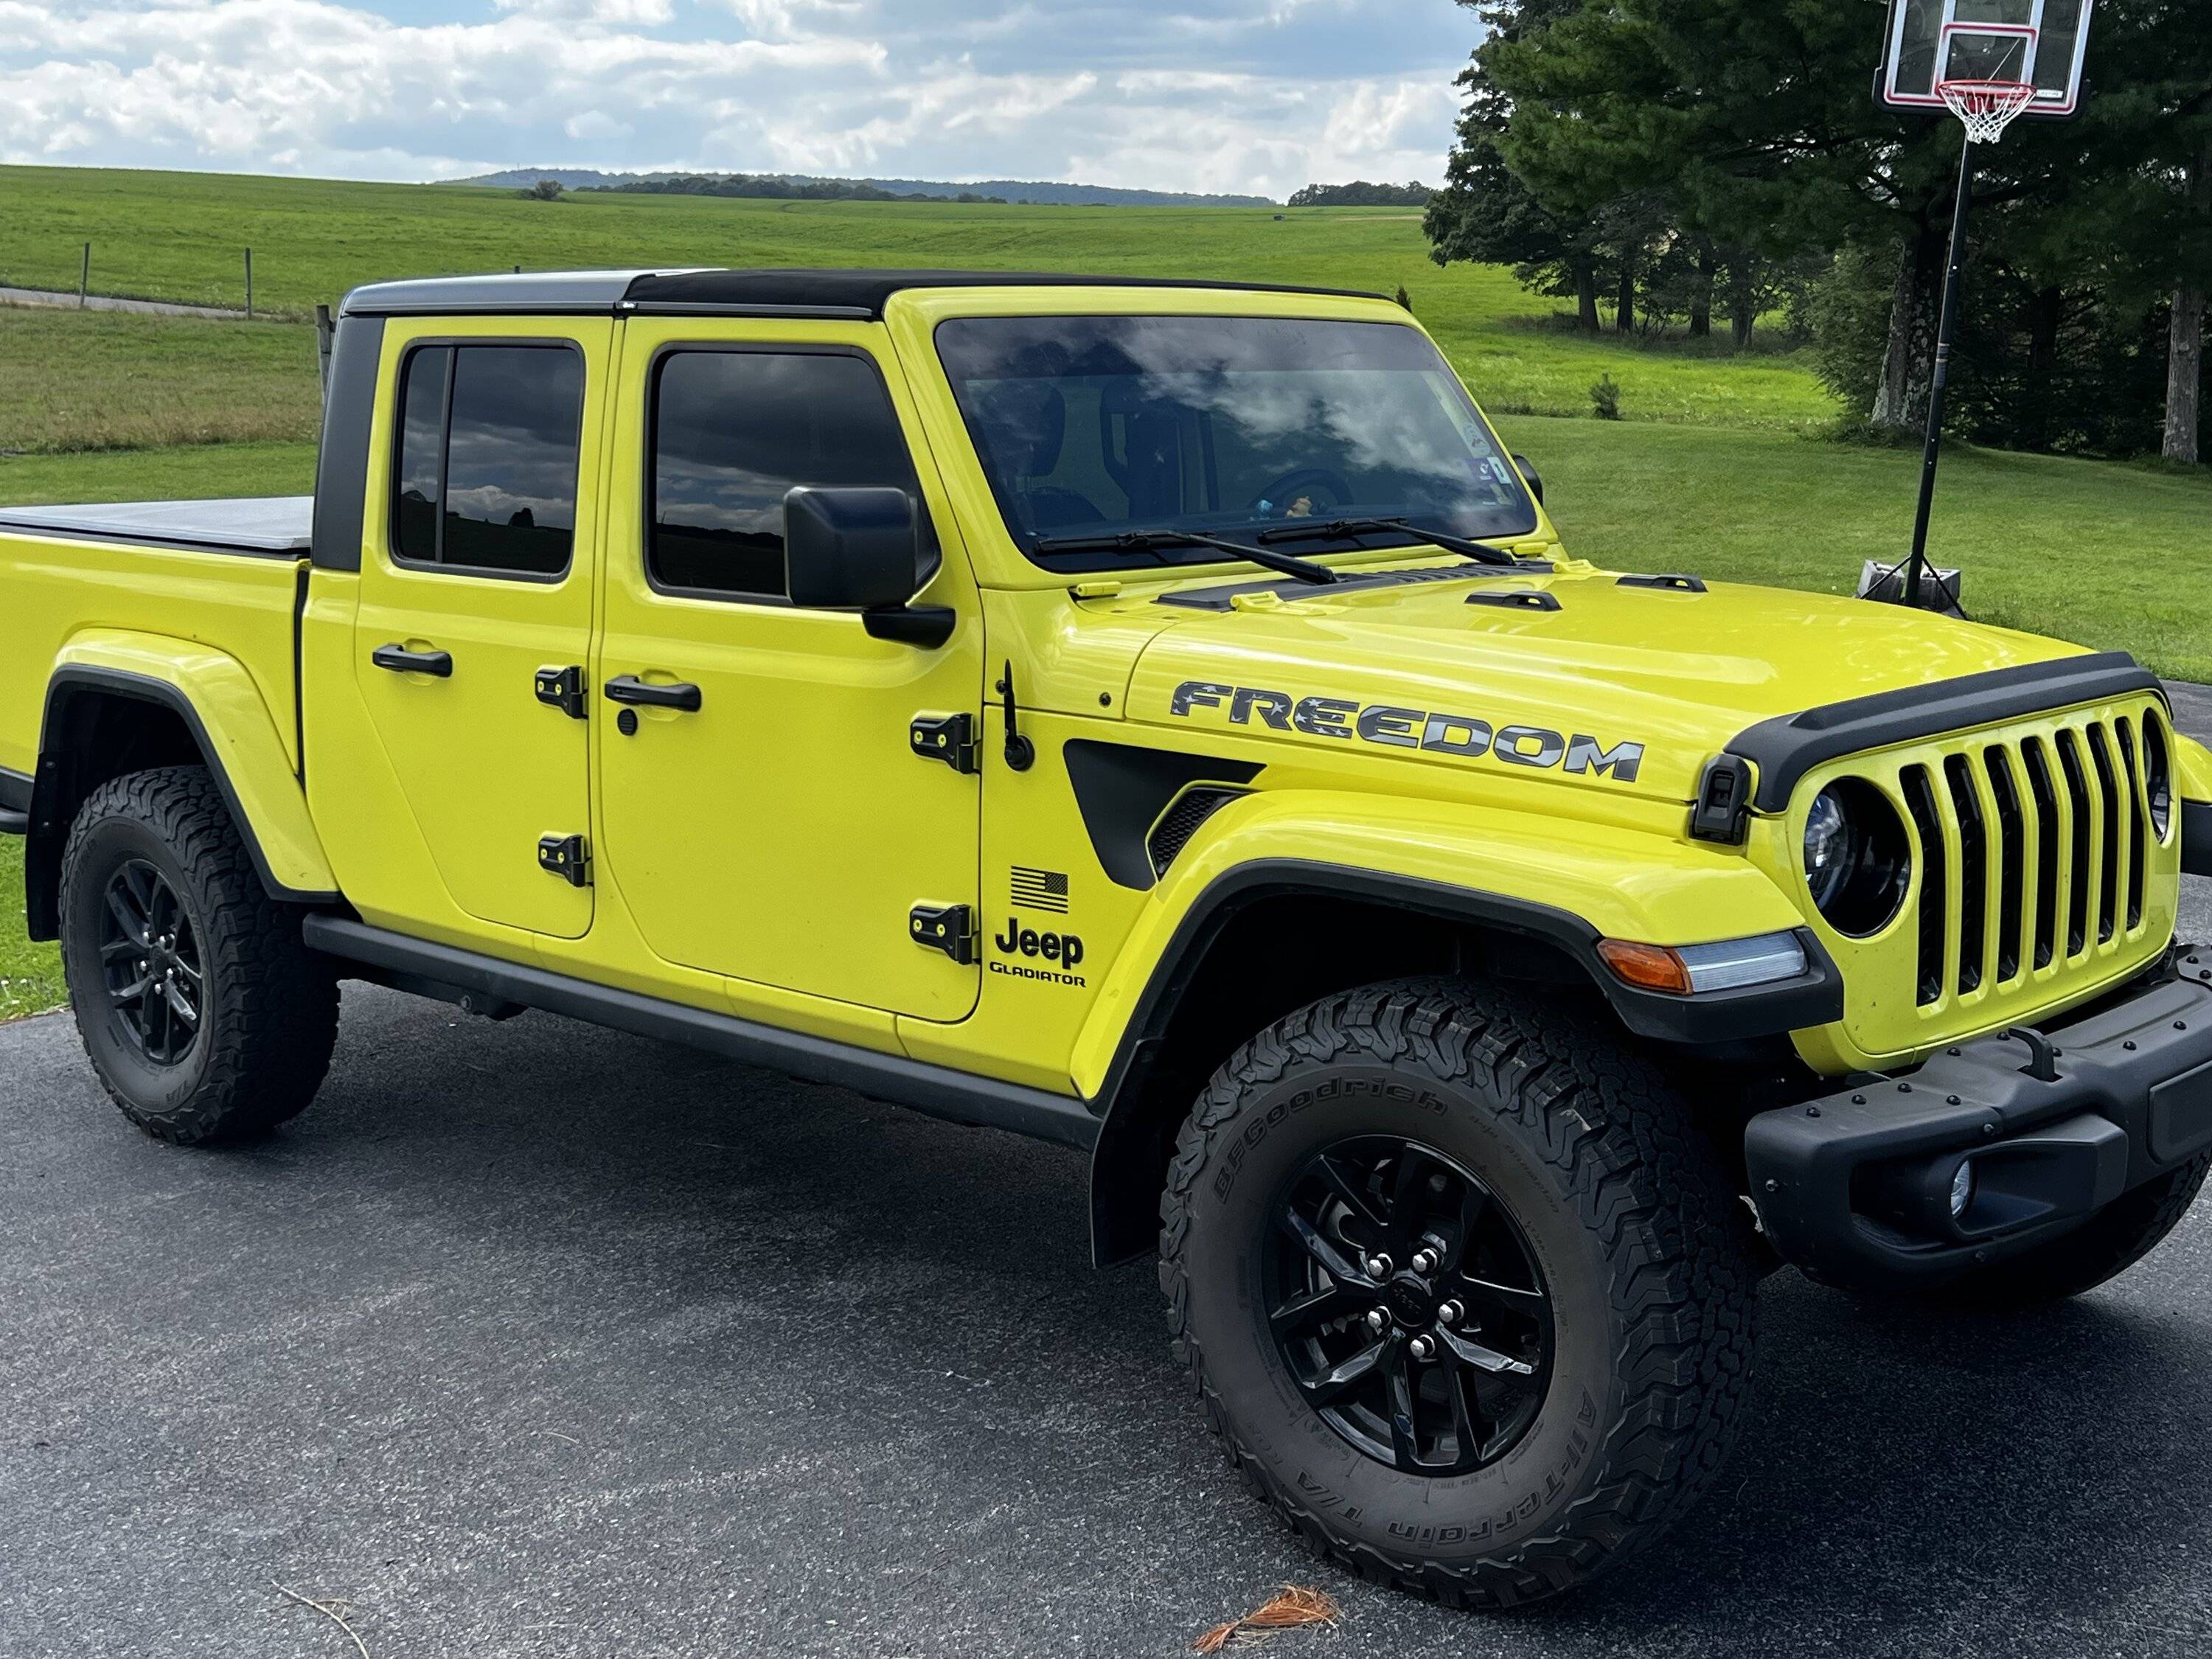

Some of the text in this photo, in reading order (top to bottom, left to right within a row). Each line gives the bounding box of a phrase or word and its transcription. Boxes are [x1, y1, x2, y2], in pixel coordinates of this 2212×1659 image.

[1171, 681, 1644, 782] FREEDOM
[995, 917, 1083, 970] Jeep
[990, 961, 1086, 988] GLADIATOR
[1213, 1075, 1449, 1204] BFGoodrich
[1297, 1471, 1363, 1528] T/A
